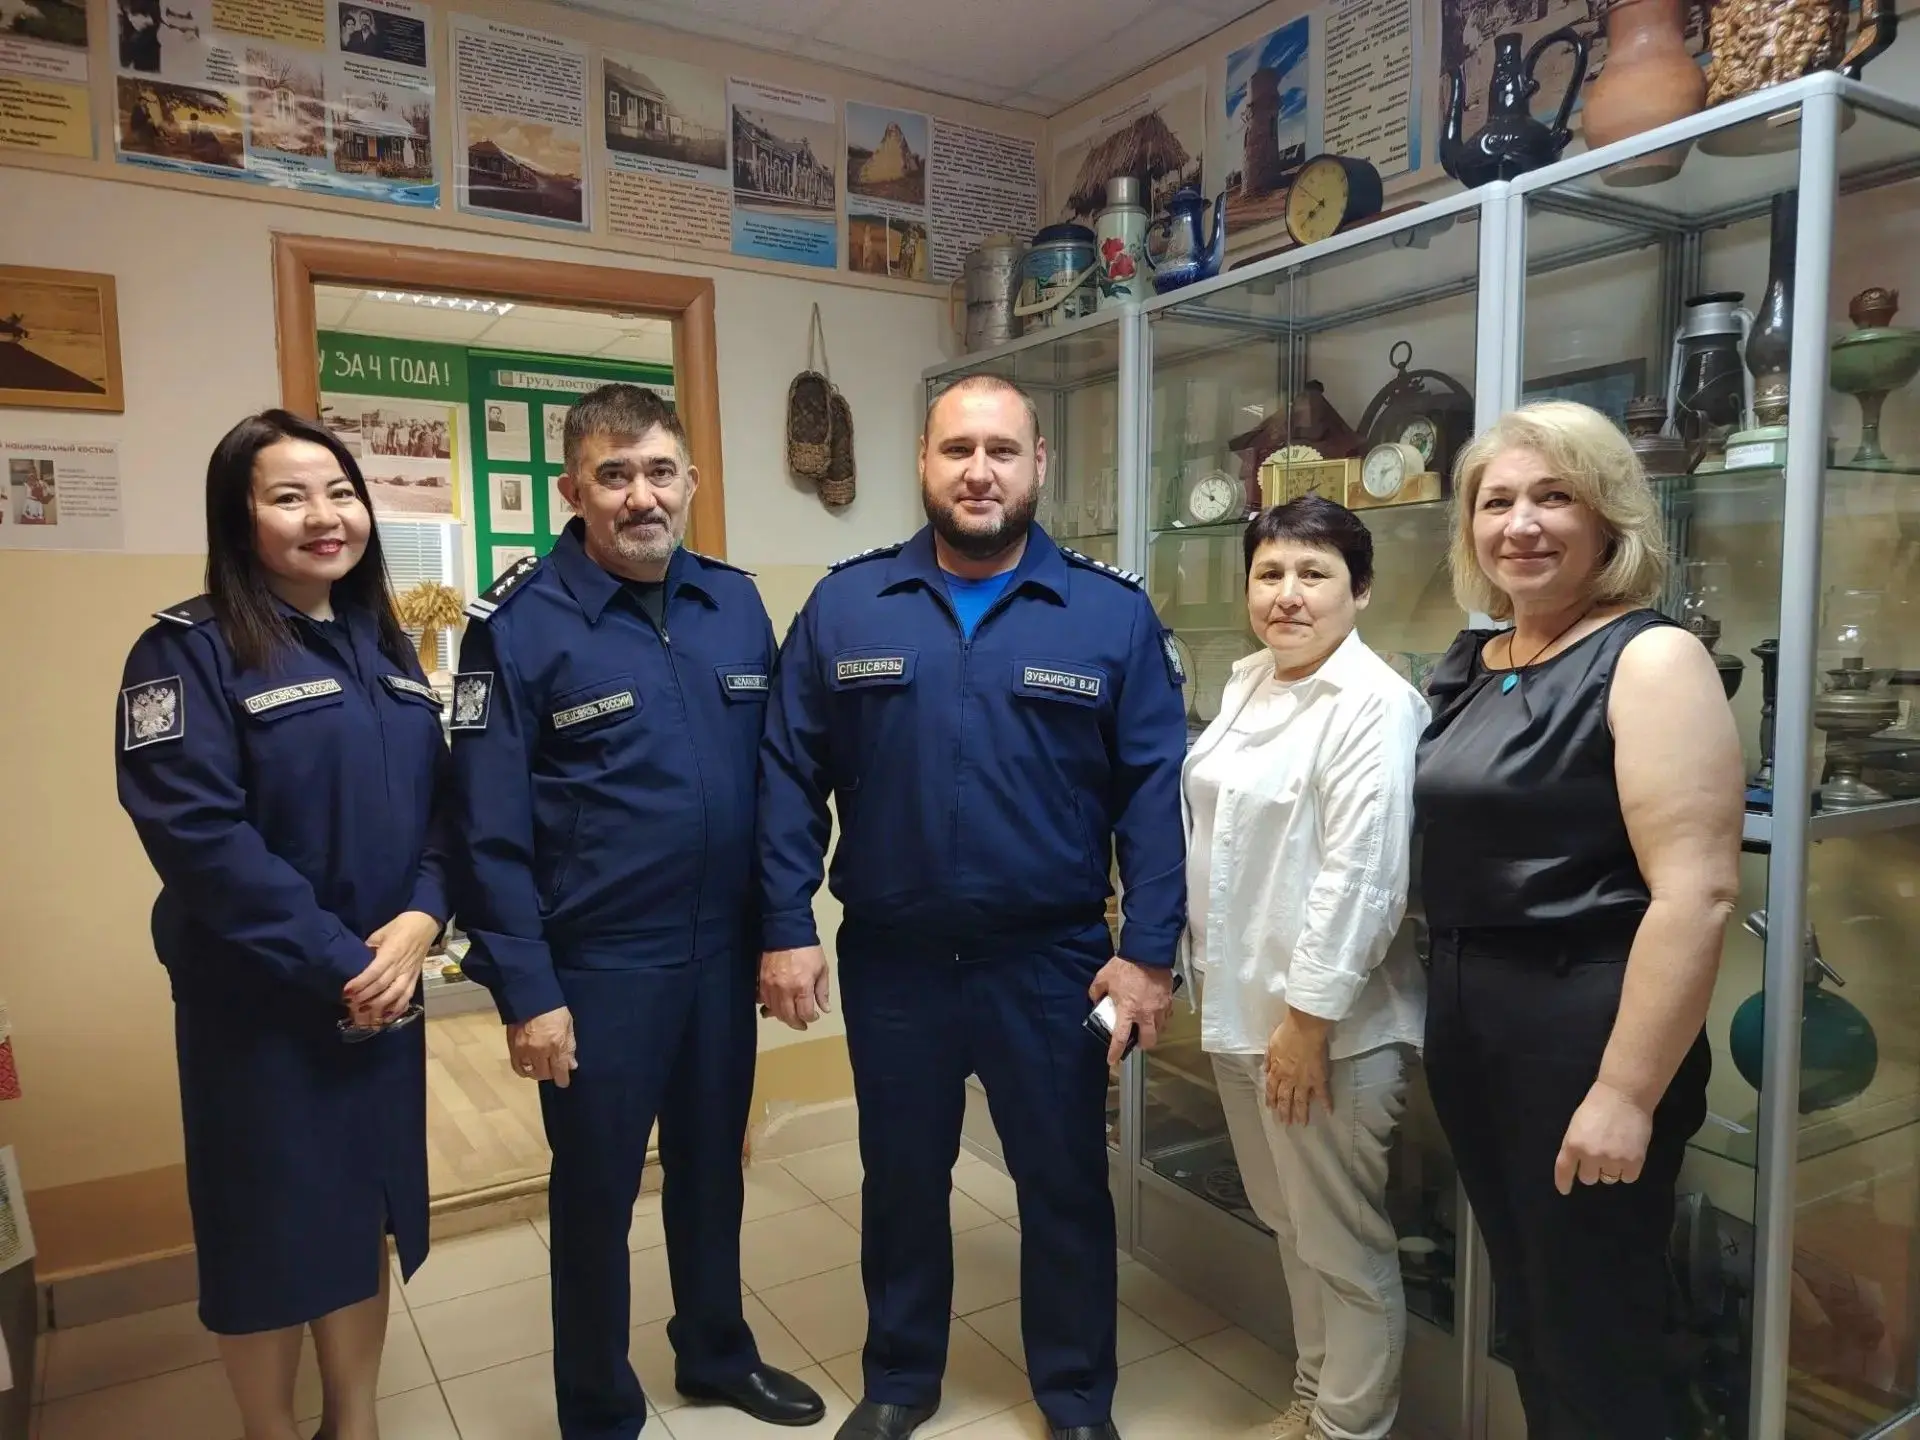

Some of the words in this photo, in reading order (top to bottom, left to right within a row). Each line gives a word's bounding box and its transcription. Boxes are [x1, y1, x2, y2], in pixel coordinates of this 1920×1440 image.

[335, 351, 365, 379] ЗА
[369, 354, 382, 381] 4
[389, 356, 450, 387] ГОДА!
[840, 660, 902, 675] СПЕЦСВЯЗЬ
[1027, 670, 1076, 687] ЗУБАИРОВ
[1079, 679, 1098, 692] В.И.
[249, 687, 304, 710] СПЕЦСВЯЗЬ
[303, 680, 339, 696] РОССИИ
[555, 706, 599, 726] СПЕЦСВЯЗЬ
[598, 695, 630, 712] РОССИИ
